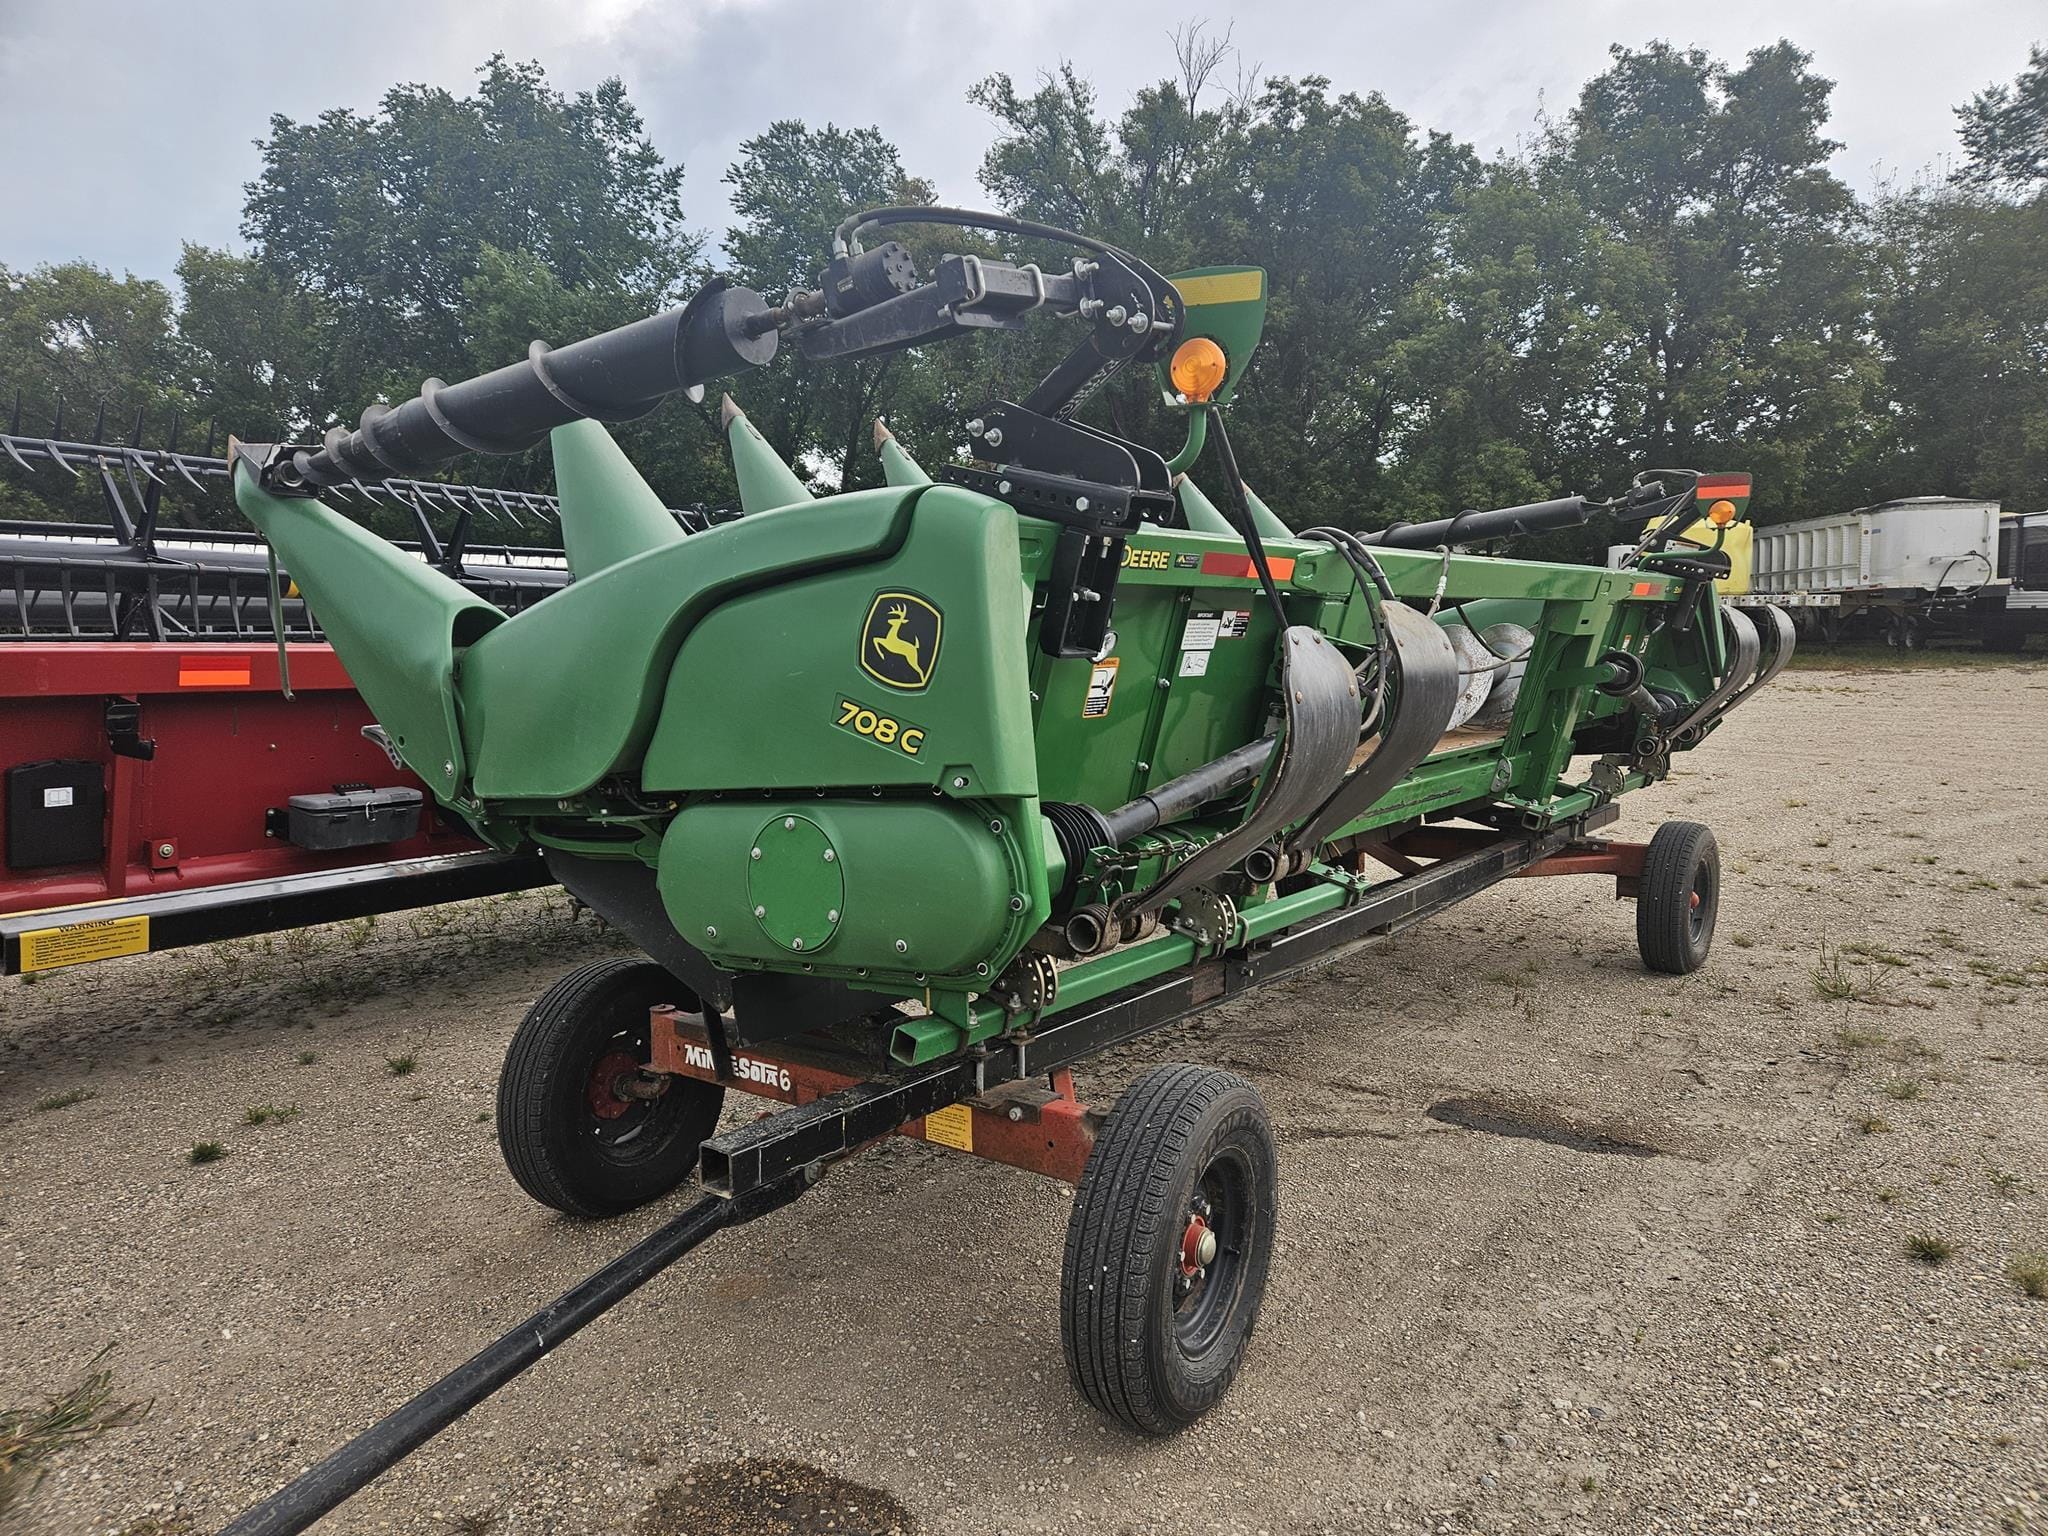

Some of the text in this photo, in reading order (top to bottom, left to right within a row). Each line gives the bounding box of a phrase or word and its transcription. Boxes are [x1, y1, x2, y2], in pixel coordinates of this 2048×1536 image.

[838, 701, 925, 755] 708 C
[59, 919, 114, 933] WARNING
